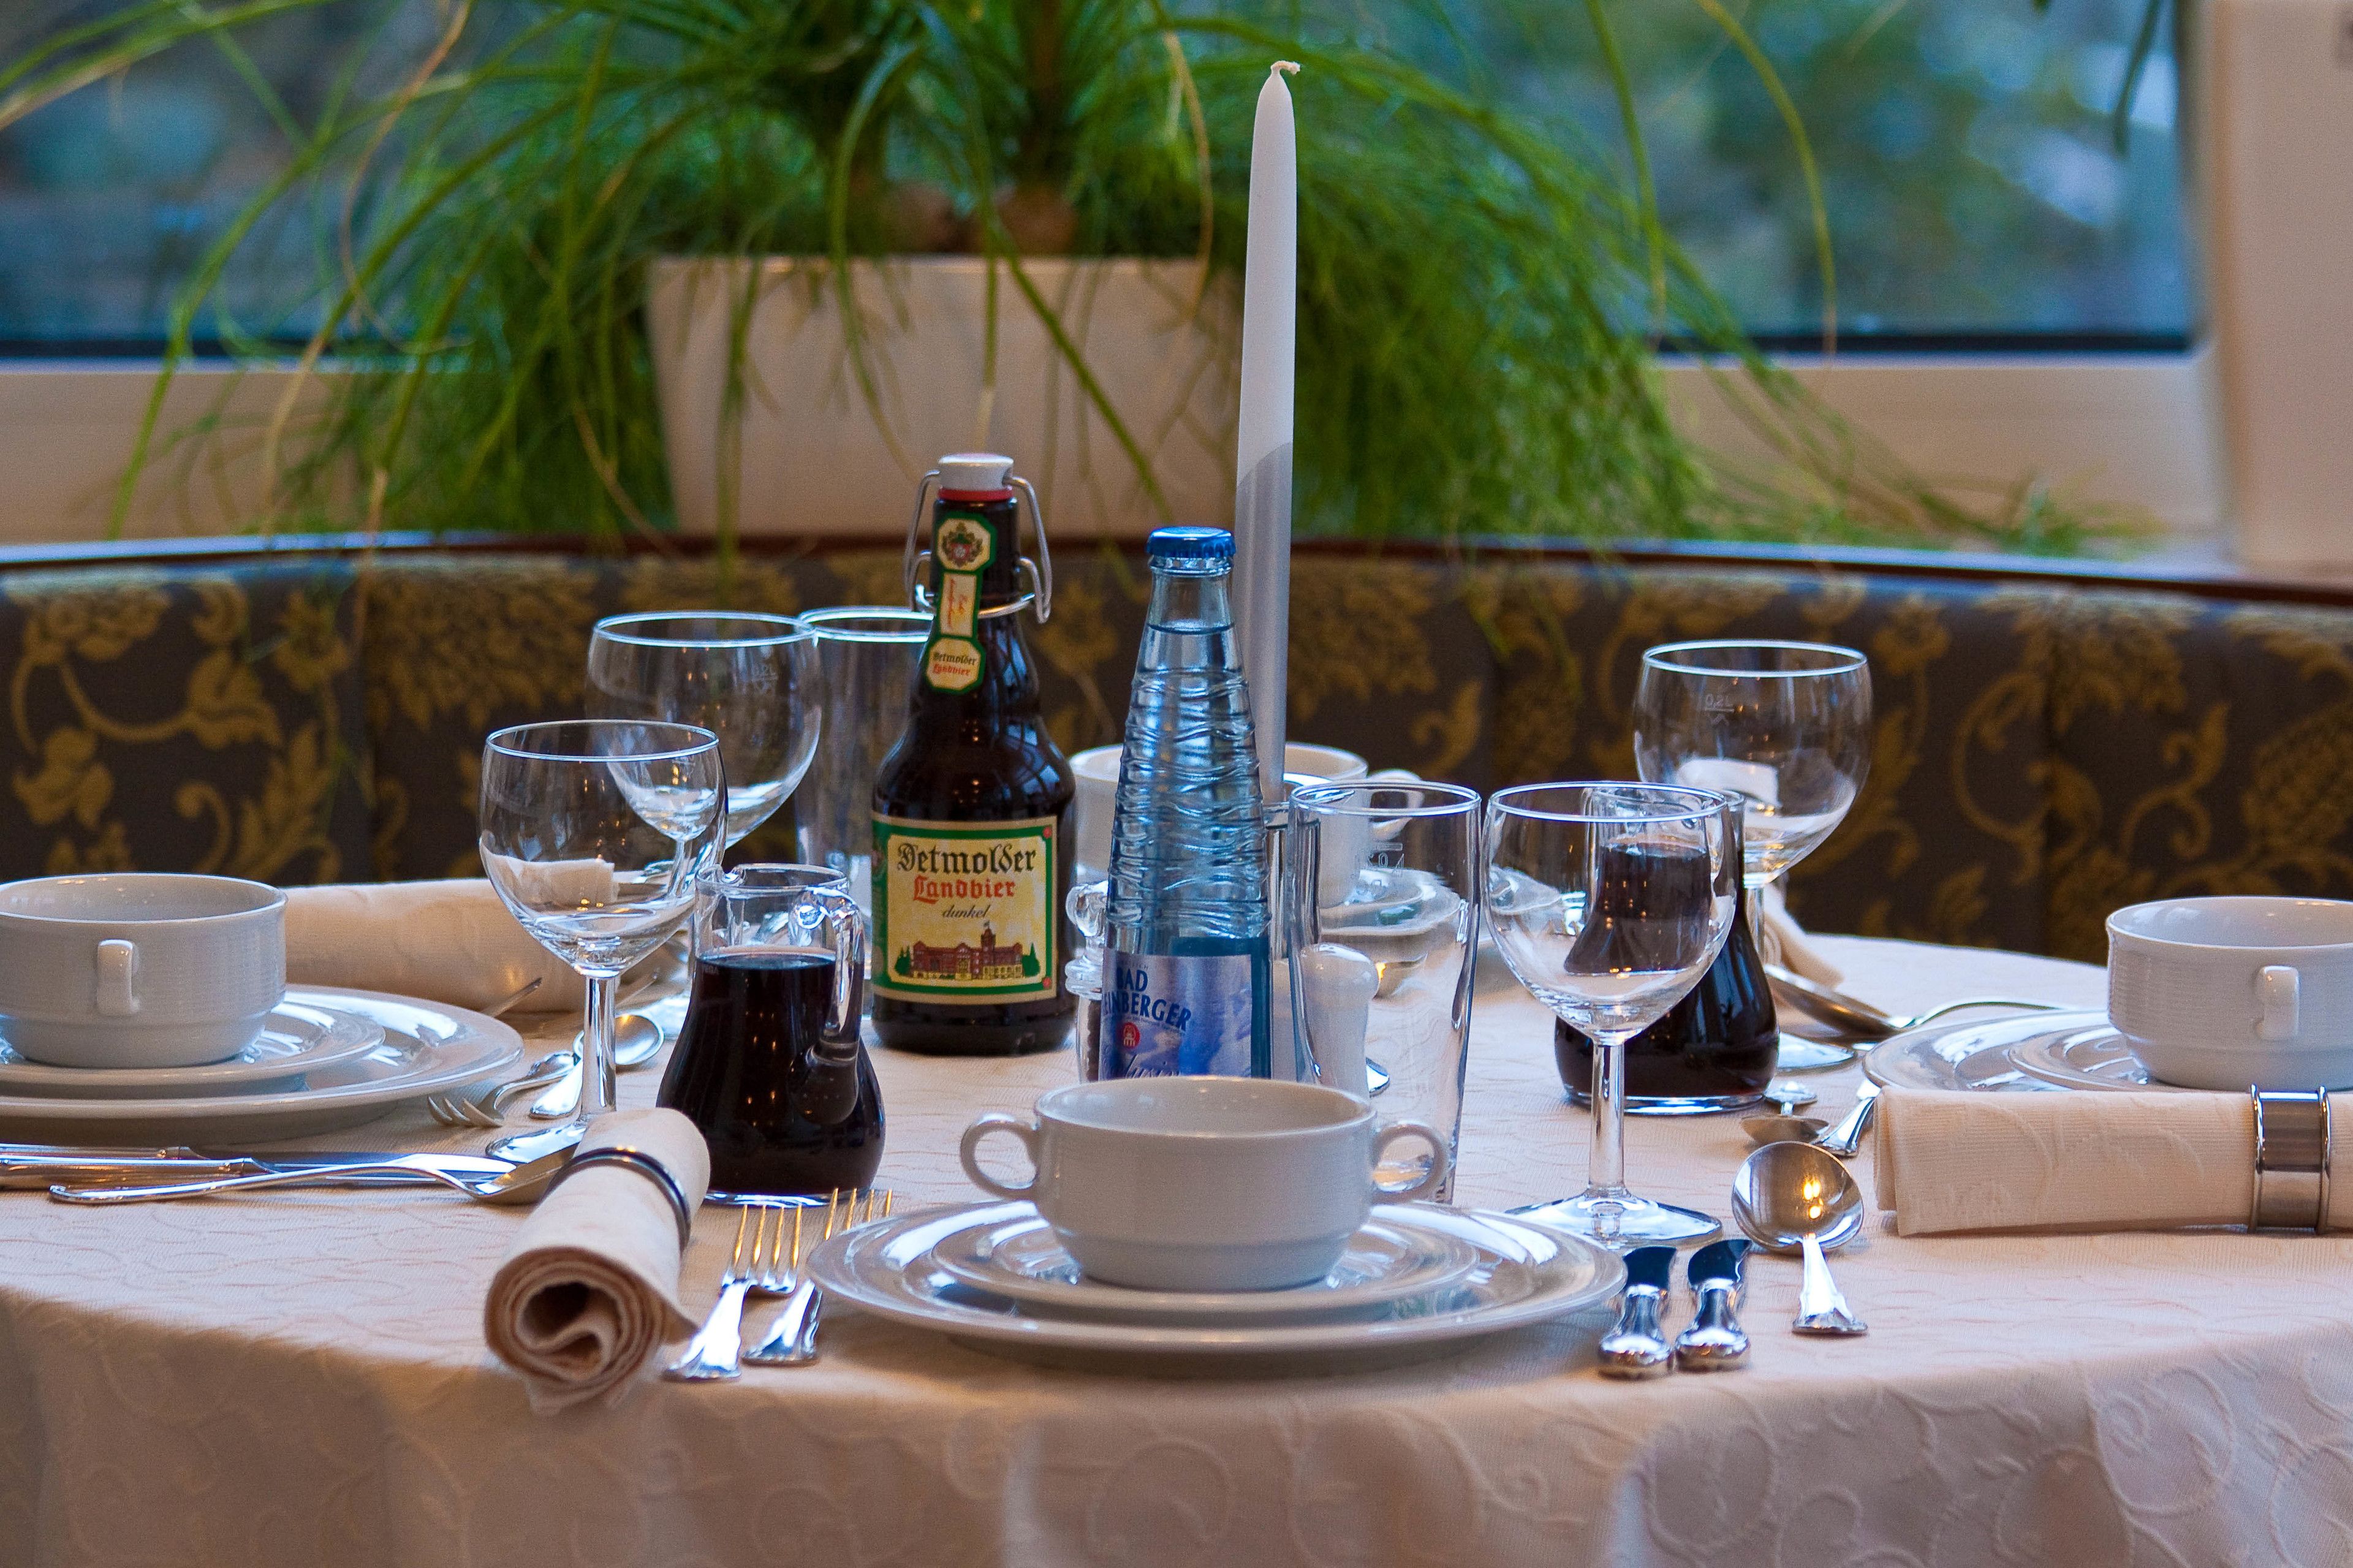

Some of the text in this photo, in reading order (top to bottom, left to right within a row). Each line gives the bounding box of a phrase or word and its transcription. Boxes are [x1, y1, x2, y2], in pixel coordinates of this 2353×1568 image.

[897, 843, 1036, 874] Detmolder
[913, 874, 1016, 904] Landbier
[942, 904, 991, 918] dunkel
